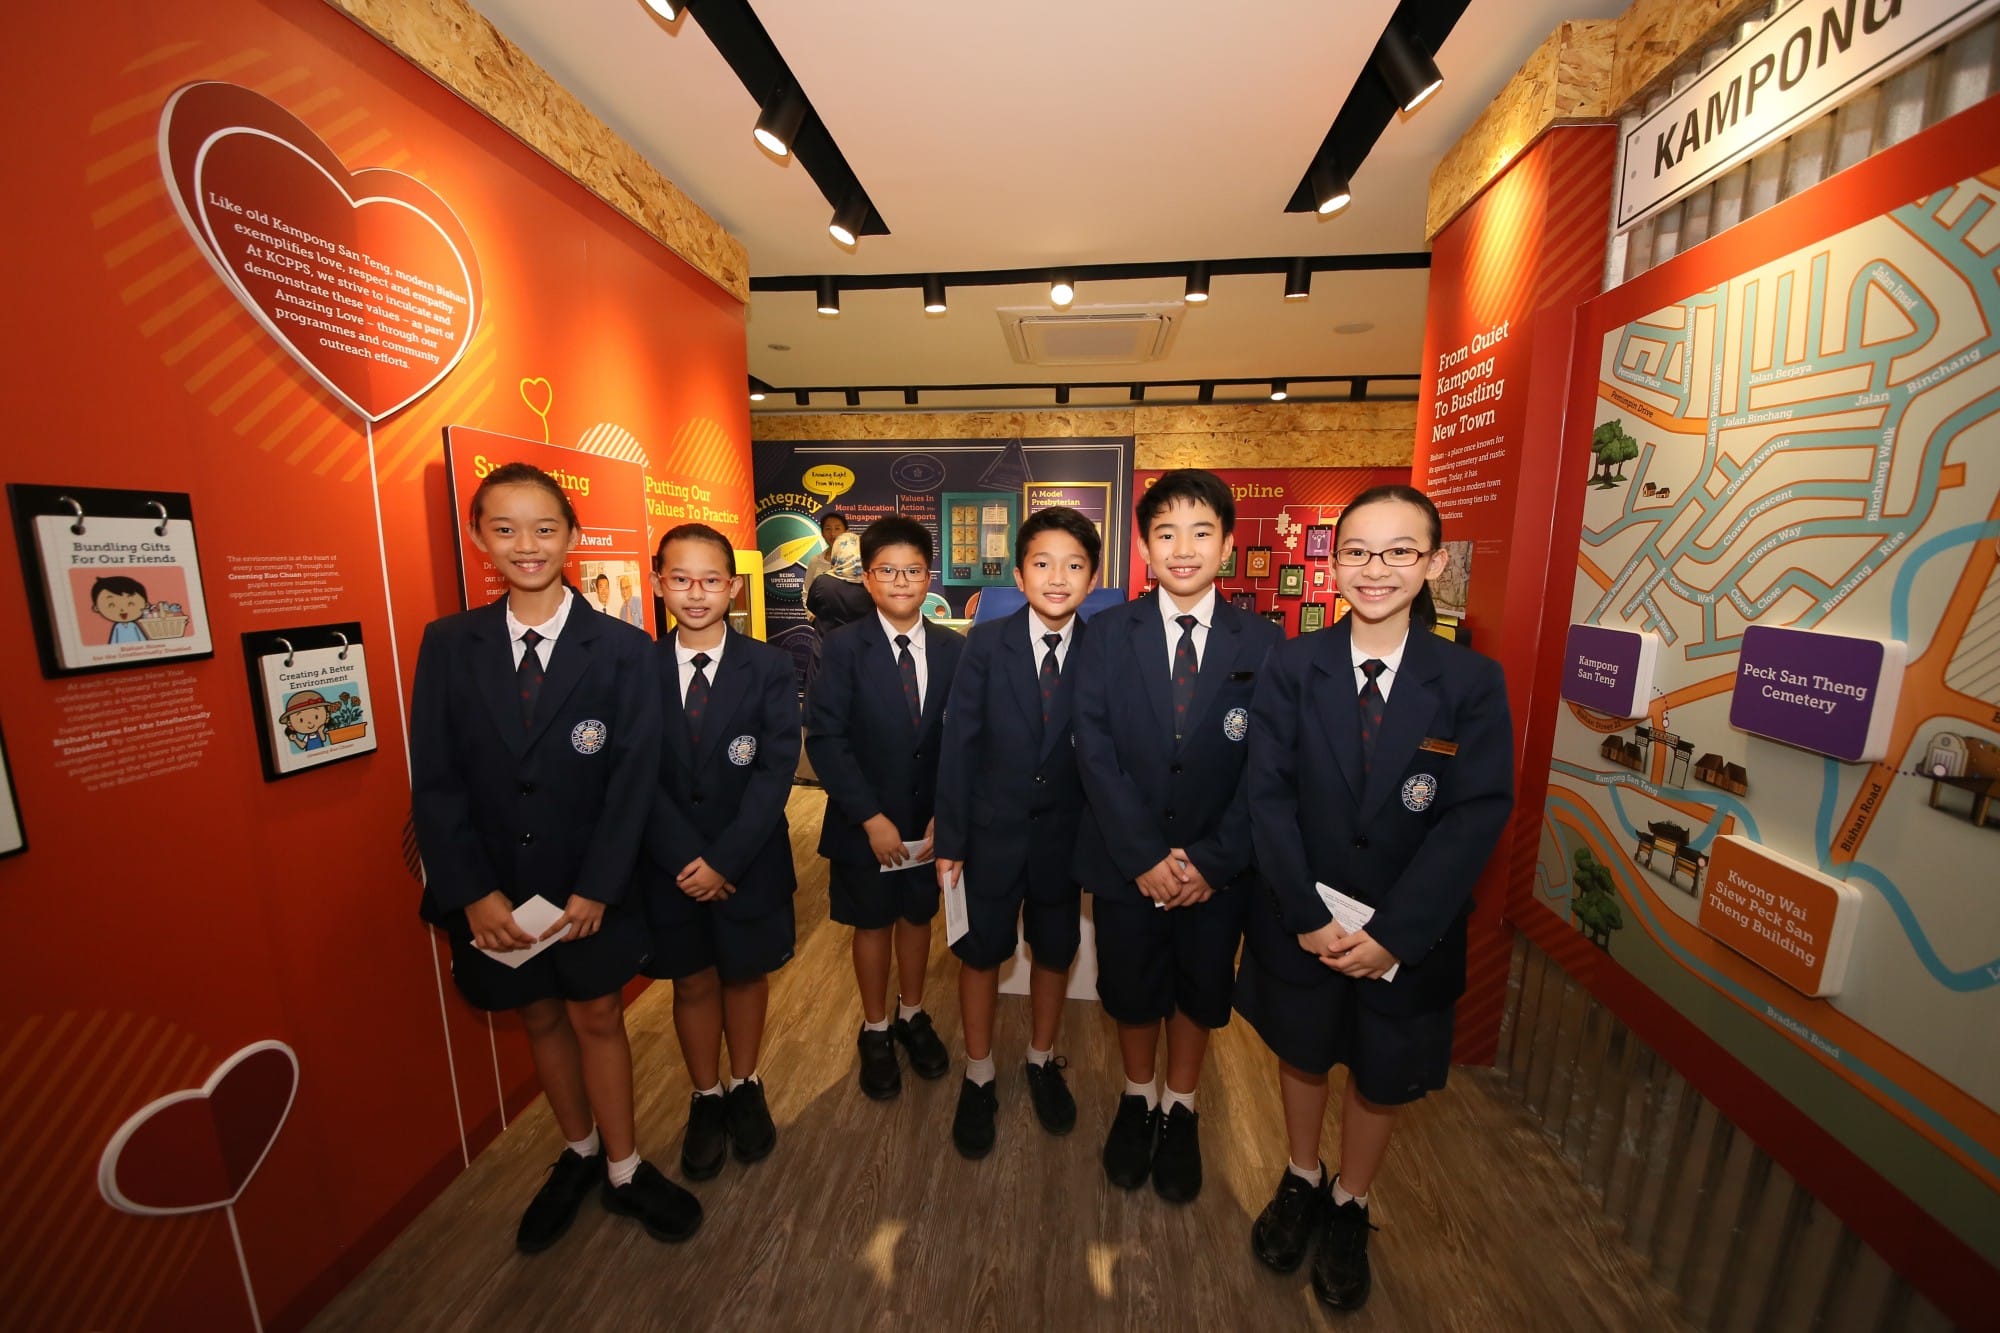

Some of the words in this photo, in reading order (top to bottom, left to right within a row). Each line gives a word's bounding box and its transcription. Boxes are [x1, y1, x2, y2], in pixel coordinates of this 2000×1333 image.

[209, 191, 242, 214] Like
[246, 210, 269, 225] old
[272, 217, 335, 253] Kampong
[338, 244, 360, 261] San
[362, 254, 393, 276] Teng,
[395, 269, 435, 292] modern
[436, 284, 467, 305] Bishan
[234, 223, 314, 260] exemplifies
[317, 252, 345, 272] love,
[348, 266, 388, 288] respect
[391, 282, 411, 297] and
[412, 291, 455, 314] empathy.
[1872, 266, 1894, 290] Jalan
[244, 261, 330, 298] demonstrate
[332, 291, 364, 310] these
[365, 303, 401, 322] values
[411, 319, 423, 329] as
[424, 324, 443, 336] part
[445, 330, 454, 341] of
[246, 244, 262, 258] At
[265, 250, 314, 277] KCPPS,
[317, 270, 335, 284] we
[338, 278, 370, 296] strive
[372, 289, 384, 301] to
[386, 295, 432, 319] inculcate
[433, 313, 451, 326] and
[275, 288, 333, 317] Amazing
[336, 308, 364, 325] Love
[377, 321, 419, 343] through
[421, 337, 438, 349] our
[275, 307, 356, 338] programmes
[358, 332, 380, 345] and
[381, 339, 440, 365] community
[1439, 345, 1468, 372] From
[1471, 320, 1509, 354] Quiet
[319, 337, 371, 359] outreach
[374, 351, 410, 369] efforts.
[1436, 356, 1495, 396] Kampong
[1748, 373, 1773, 384] Jalan
[1776, 364, 1812, 378] Berjaya
[1855, 392, 1889, 406] Jalan
[1906, 348, 1981, 394] Binchang
[1435, 401, 1448, 419] To
[1450, 379, 1504, 413] Bustling
[1710, 363, 1721, 418] Pemimpin
[1431, 423, 1457, 443] New
[1459, 409, 1495, 433] Town
[1637, 404, 1653, 418] Drive
[1723, 417, 1746, 427] Jalan
[1748, 409, 1793, 423] Binchang
[1476, 438, 1495, 450] known
[1495, 435, 1504, 444] for
[1708, 419, 1717, 447] Jalan
[1878, 426, 1895, 458] Walk
[1478, 453, 1489, 462] and
[1726, 467, 1753, 495] Clover
[1753, 439, 1790, 466] Avenue
[474, 454, 590, 496] Suting
[644, 476, 689, 502] Putting
[691, 485, 711, 502] Our
[754, 492, 823, 514] Integrity
[1031, 499, 1080, 507] Presbyterian
[1039, 490, 1063, 498] Model
[1867, 461, 1890, 522] Binchang
[646, 498, 685, 518] Values
[687, 504, 701, 520] To
[702, 506, 739, 524] Practice
[835, 504, 856, 512] Moral
[858, 504, 895, 512] Education
[1723, 517, 1749, 546] Clover
[1748, 490, 1793, 518] Crescent
[73, 542, 137, 553] Bundling
[140, 542, 171, 552] Gifts
[580, 533, 613, 547] Award
[1747, 537, 1777, 564] Clover
[1778, 526, 1802, 540] Way
[71, 555, 96, 564] For
[98, 555, 125, 564] Our
[129, 554, 176, 563] Friends
[1822, 564, 1872, 612] Binchang
[1879, 531, 1905, 556] Rise
[1627, 592, 1645, 613] Clover
[1645, 568, 1666, 593] Avenue
[1669, 577, 1690, 598] Clover
[1697, 594, 1714, 603] Way
[1730, 588, 1752, 615] Clover
[1757, 587, 1781, 609] Close
[1645, 598, 1660, 621] Clover
[279, 670, 319, 681] Creating
[321, 668, 328, 676] A
[329, 664, 354, 674] Better
[1577, 668, 1593, 680] San
[1594, 672, 1616, 688] Teng
[1579, 655, 1619, 675] Kampong
[289, 674, 348, 690] Environment
[1743, 663, 1777, 681] Peck
[1779, 669, 1808, 687] San
[1812, 675, 1868, 701] Theng
[1761, 684, 1837, 714] Cemetery
[1626, 773, 1640, 786] San
[1640, 780, 1658, 796] Teng
[1840, 815, 1867, 853] Bishan
[1862, 783, 1882, 814] Road
[1727, 869, 1775, 906] Kwong
[1779, 895, 1808, 921] Wai
[1715, 880, 1746, 906] Siew
[1748, 898, 1783, 927] Peck
[1785, 919, 1814, 945] San
[1709, 893, 1750, 928] Theng
[1752, 918, 1816, 967] Building
[1767, 1005, 1809, 1039] Braddell
[1810, 1032, 1840, 1058] Road
